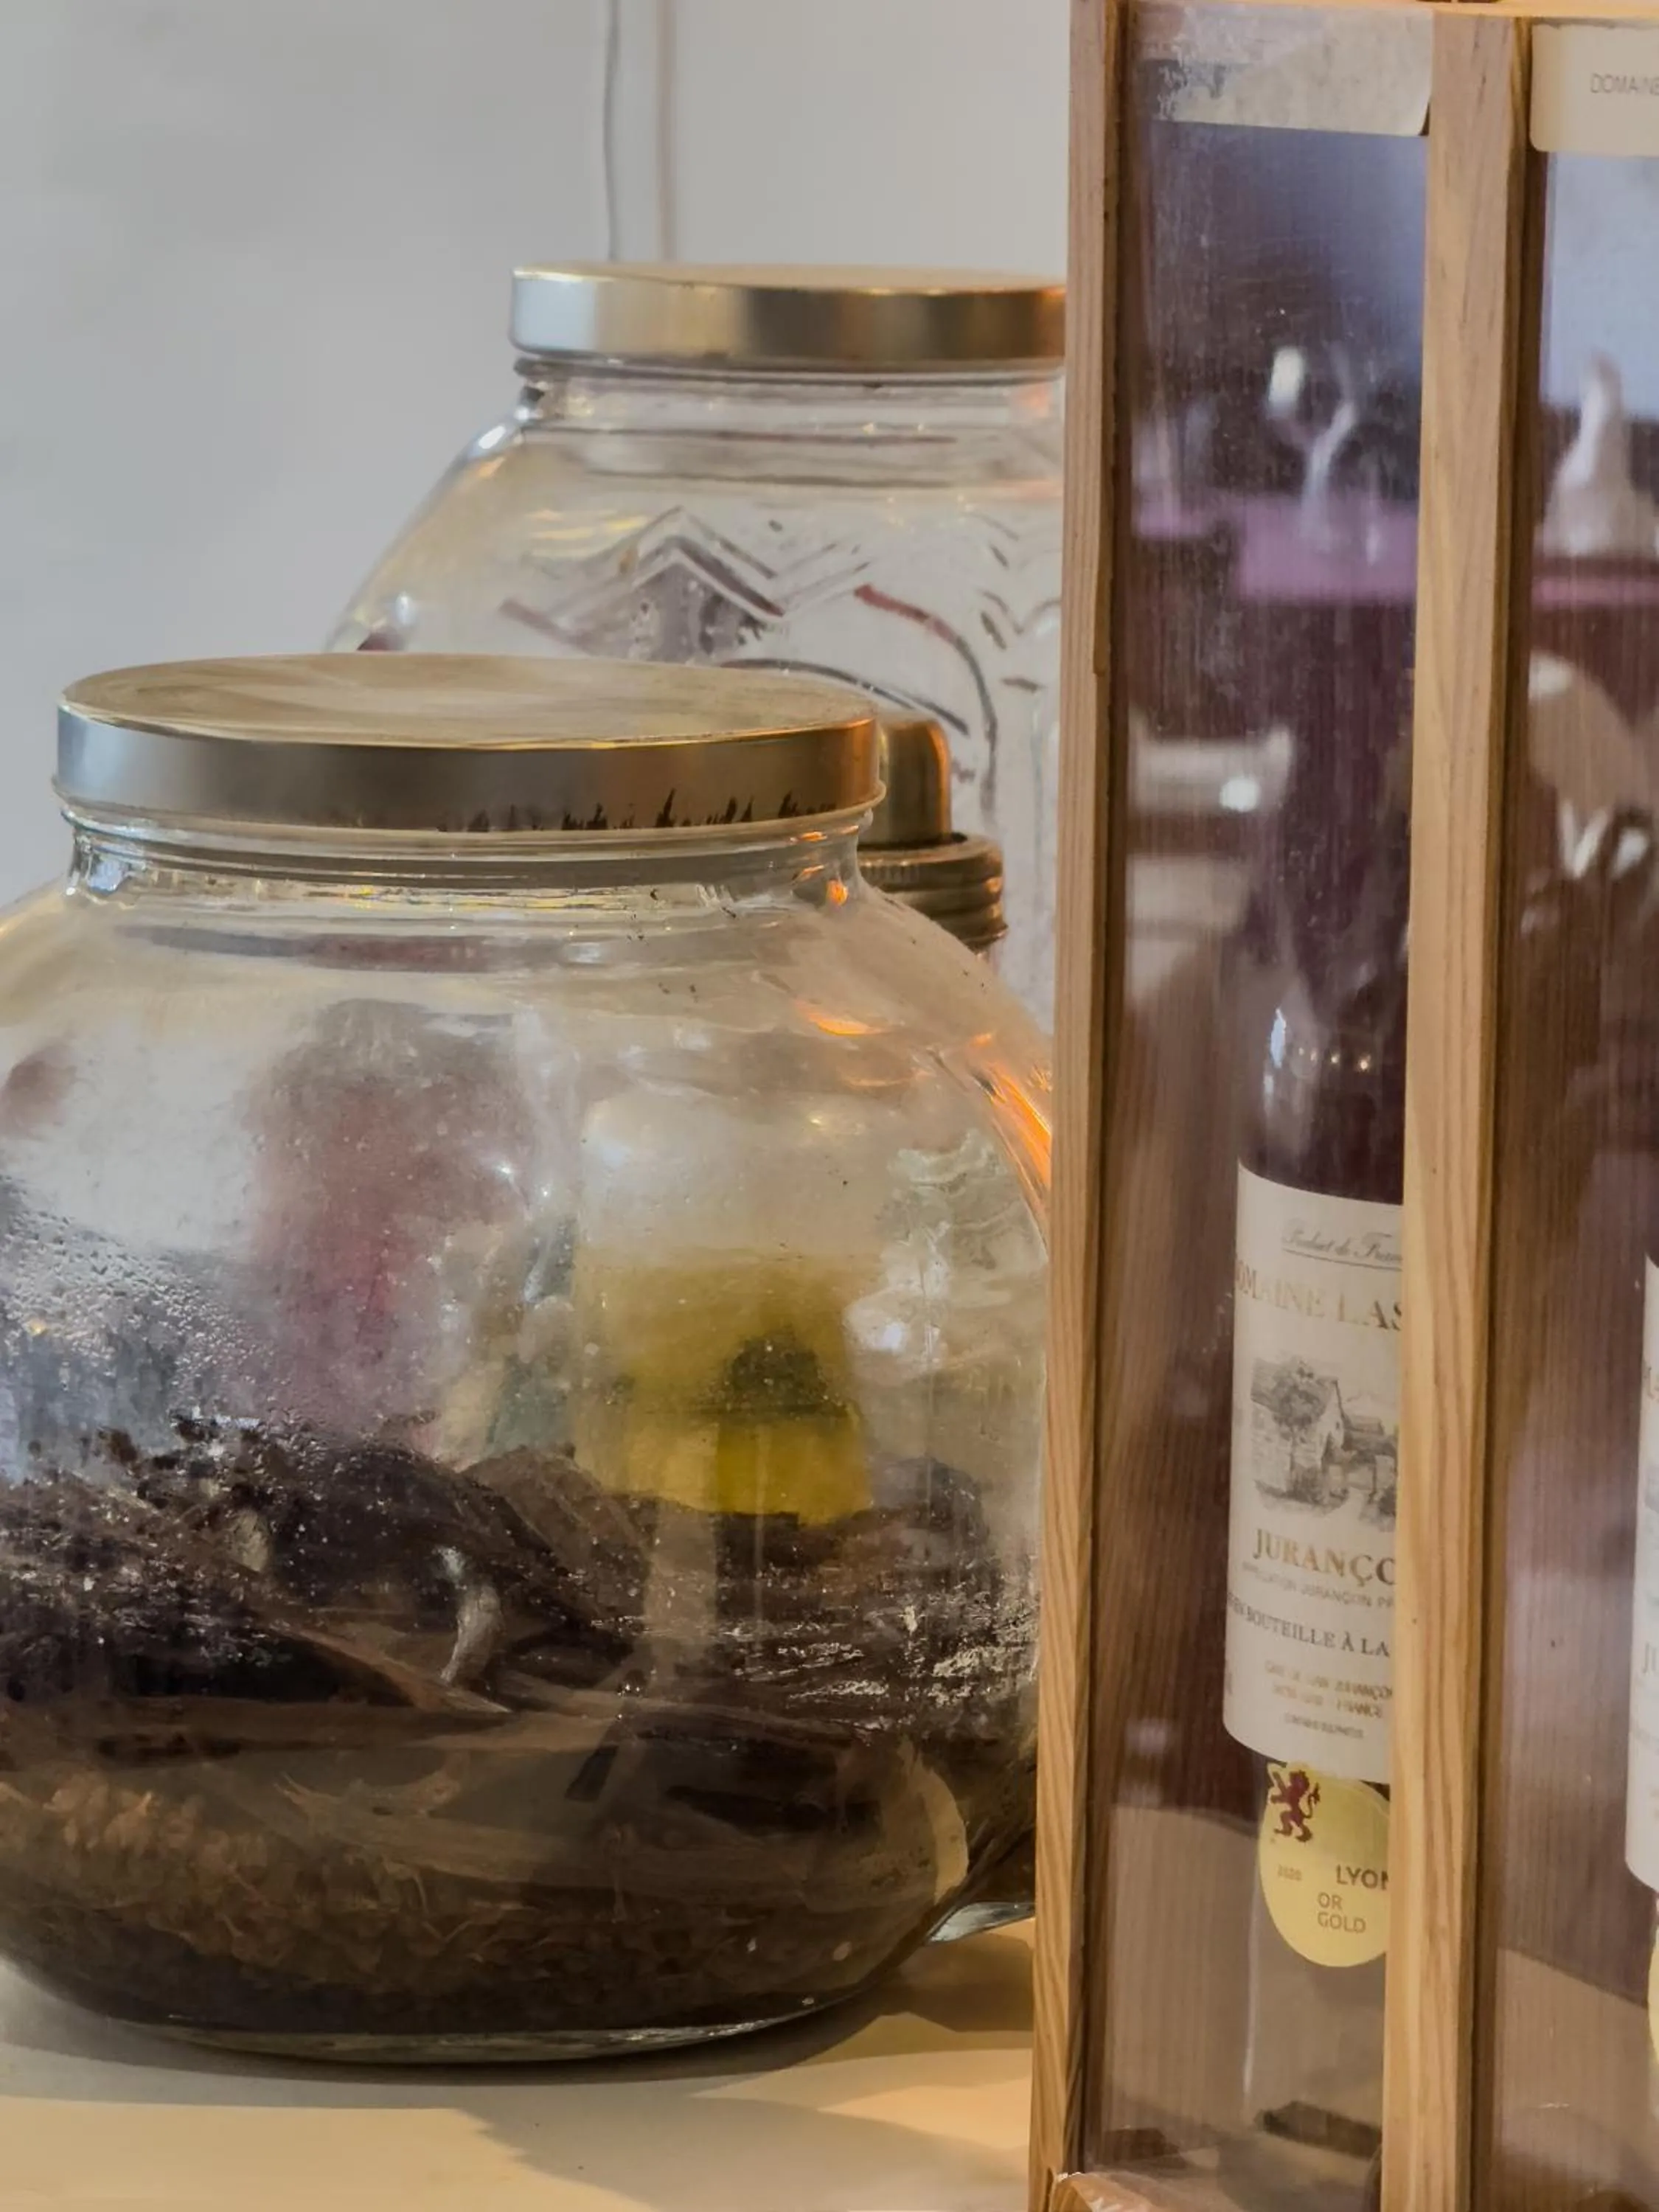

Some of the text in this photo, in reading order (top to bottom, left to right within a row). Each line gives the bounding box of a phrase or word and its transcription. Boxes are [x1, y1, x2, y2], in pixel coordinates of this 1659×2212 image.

[1246, 1605, 1335, 1649] BOUTEILLE
[1341, 1630, 1355, 1652] À
[1360, 1638, 1391, 1658] LA
[1318, 1892, 1342, 1910] OR
[1318, 1911, 1366, 1933] GOLD
